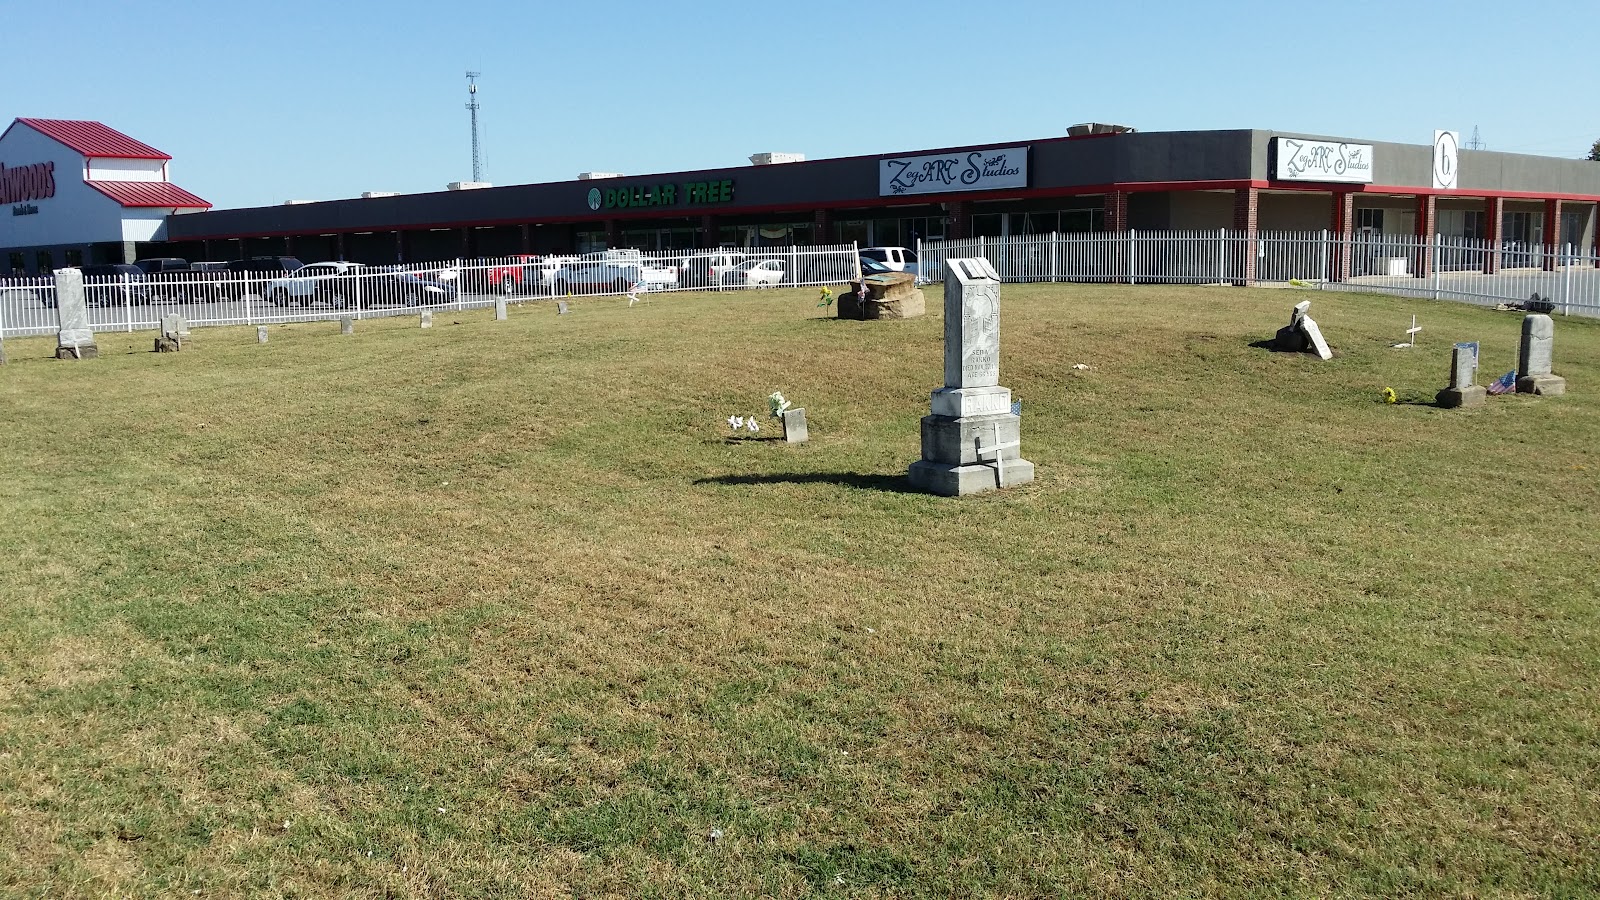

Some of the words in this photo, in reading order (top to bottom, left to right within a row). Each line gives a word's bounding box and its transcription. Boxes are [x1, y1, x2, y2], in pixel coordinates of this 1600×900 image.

[960, 152, 1020, 185] Studios
[1334, 142, 1370, 175] Studios
[604, 183, 677, 209] DOLLAR
[682, 180, 733, 203] TREE
